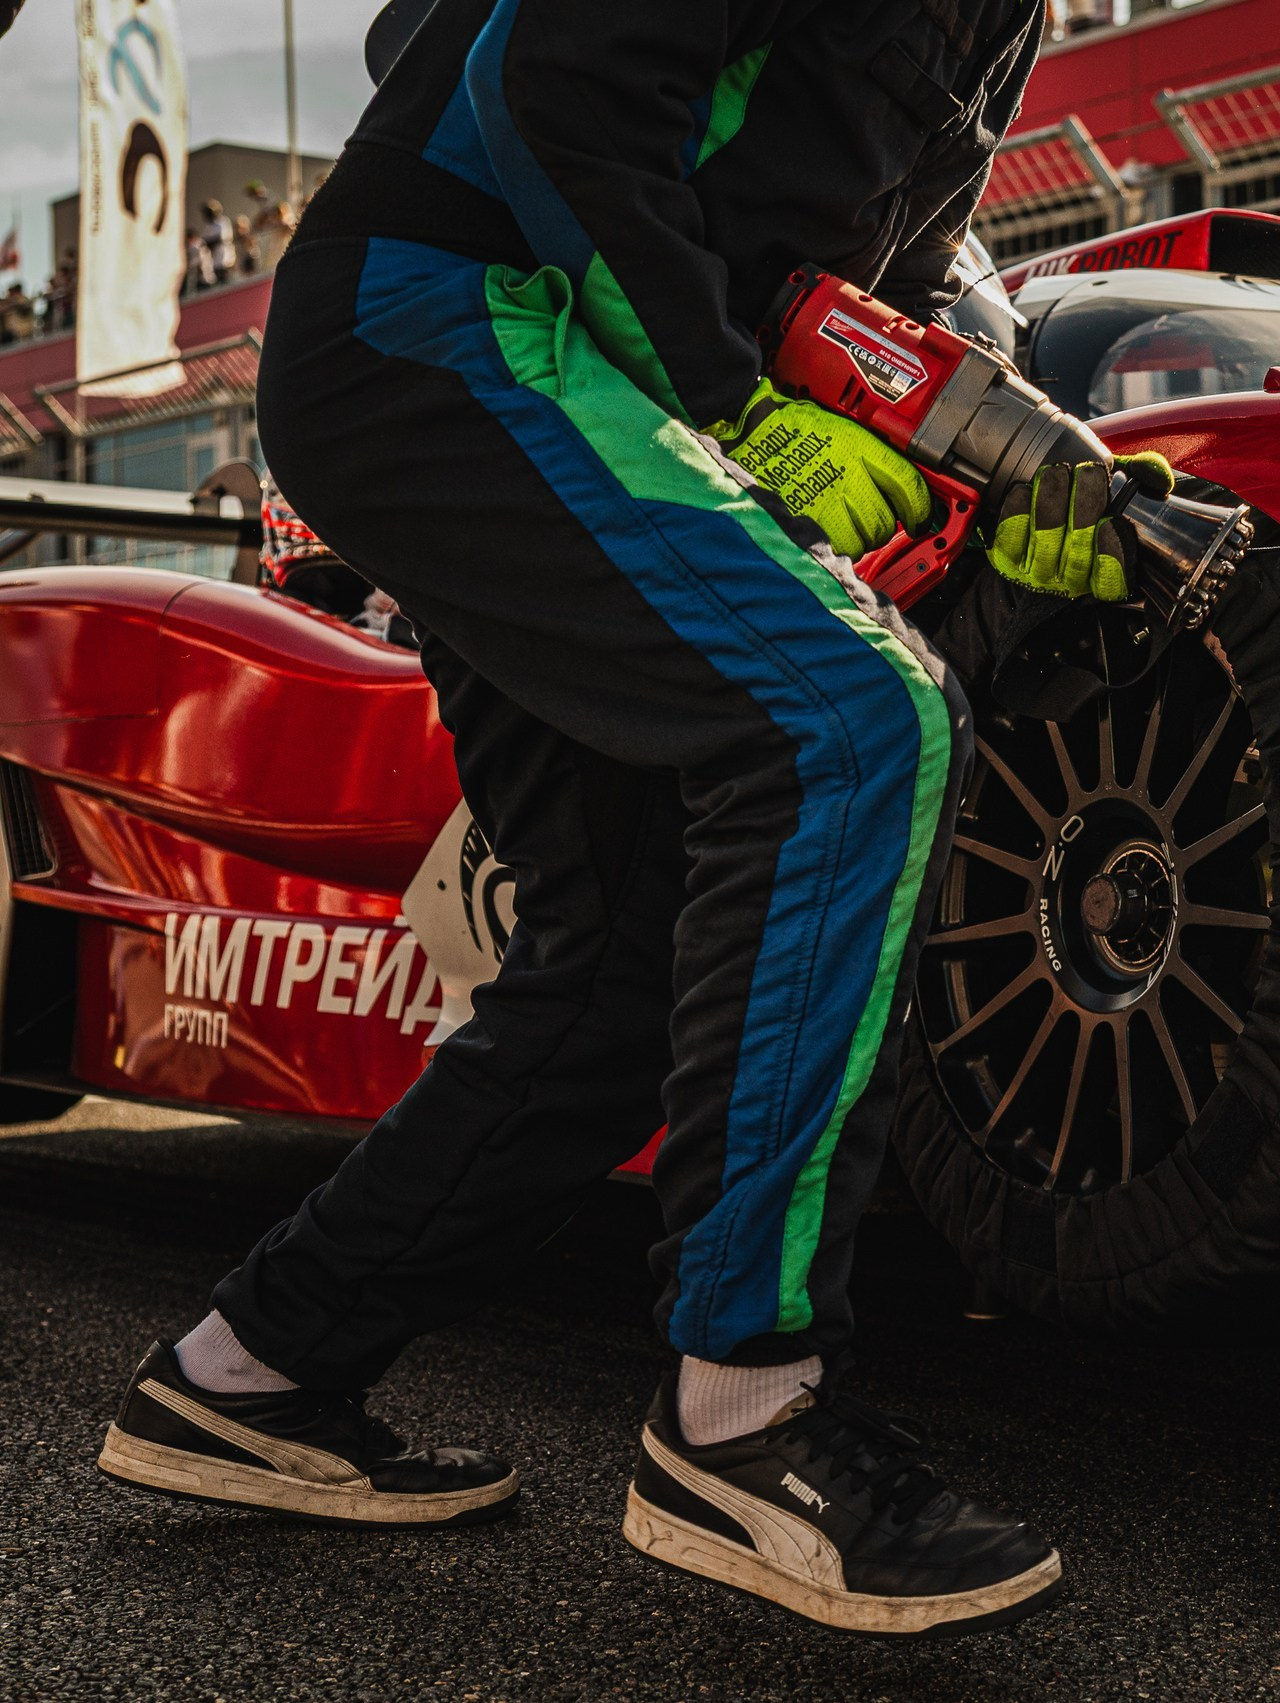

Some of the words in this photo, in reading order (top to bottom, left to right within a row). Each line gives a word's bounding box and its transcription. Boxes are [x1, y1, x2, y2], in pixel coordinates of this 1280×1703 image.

[736, 422, 797, 473] echanix
[1039, 898, 1062, 972] RACING
[164, 1003, 228, 1048] ГРУПП
[780, 1471, 818, 1506] PUMA
